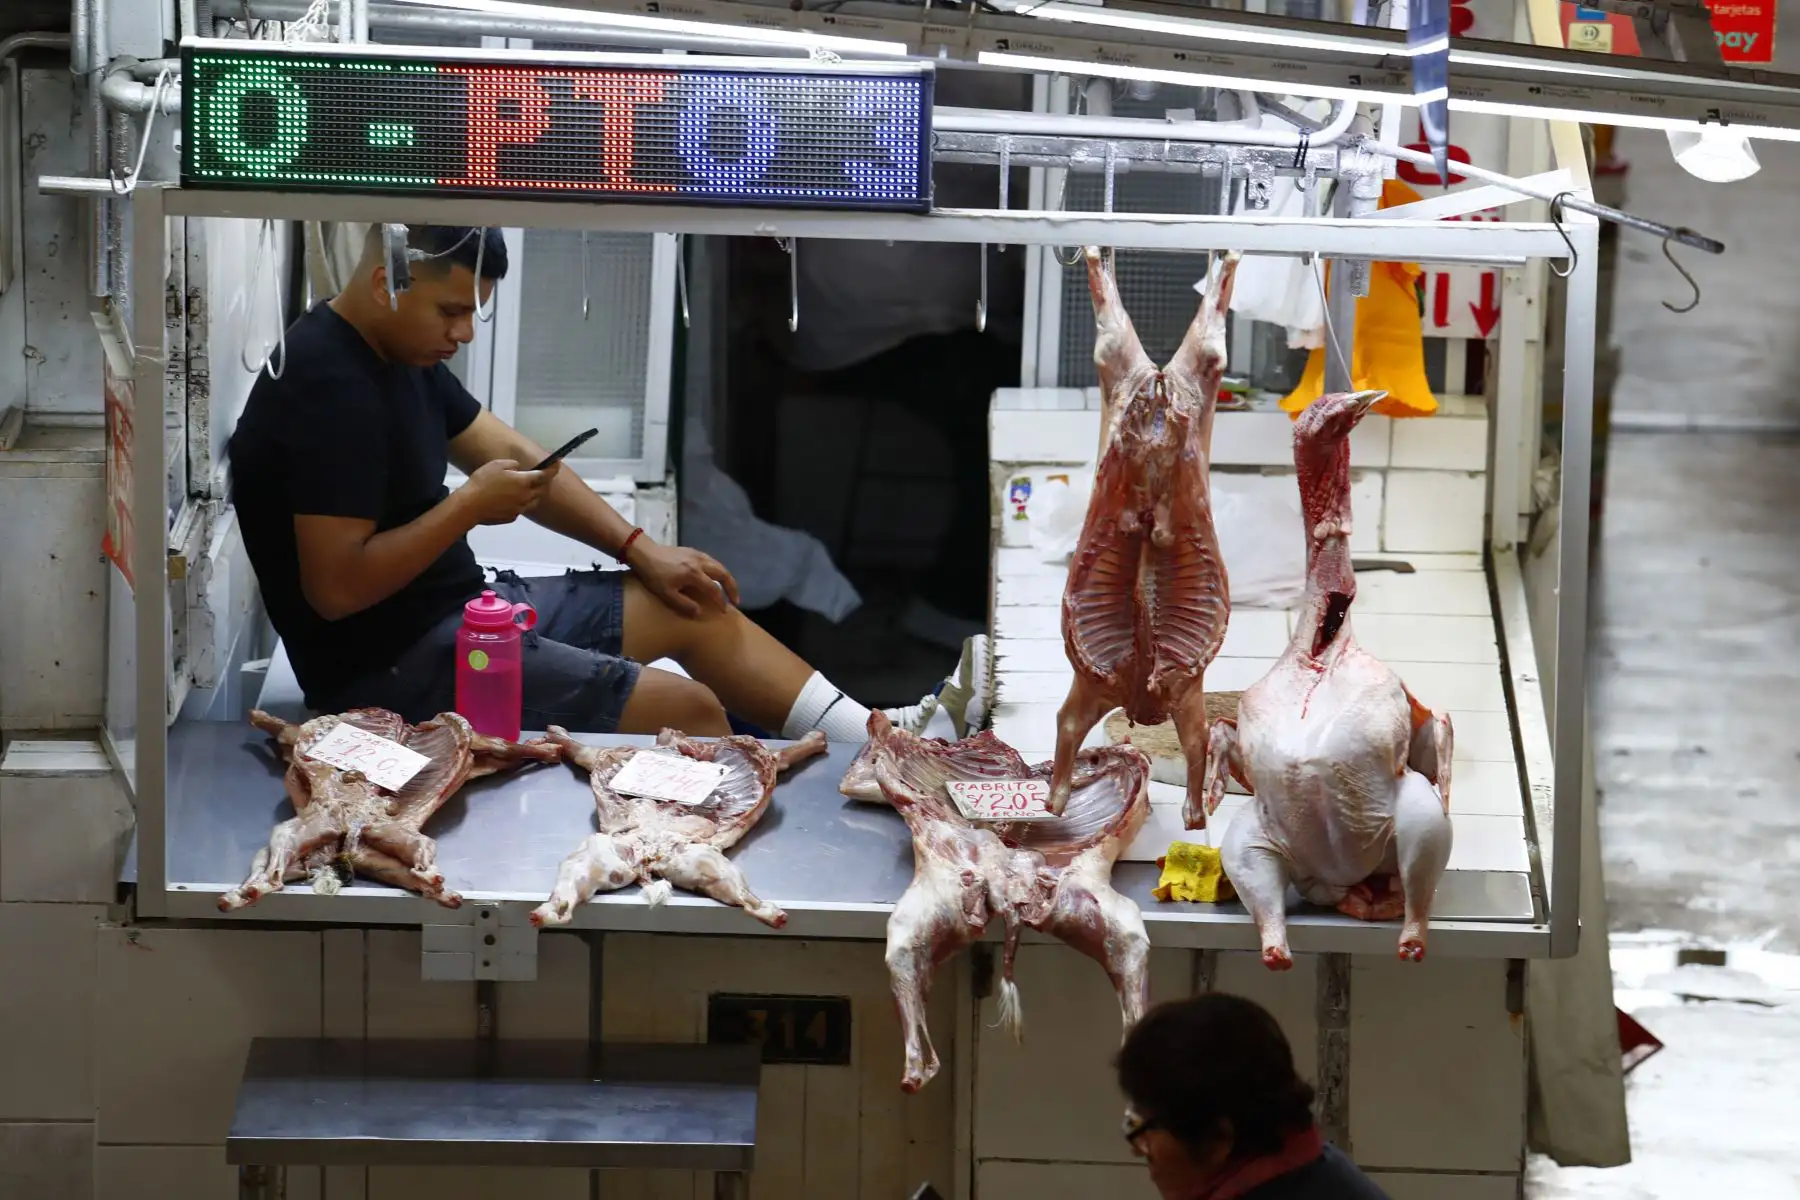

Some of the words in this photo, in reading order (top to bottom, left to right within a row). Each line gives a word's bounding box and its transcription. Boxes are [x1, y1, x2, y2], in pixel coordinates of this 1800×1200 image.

[1713, 4, 1762, 17] tarjetas
[467, 77, 777, 187] PTO
[976, 810, 1036, 818] TIERNO
[746, 1009, 828, 1050] 314
